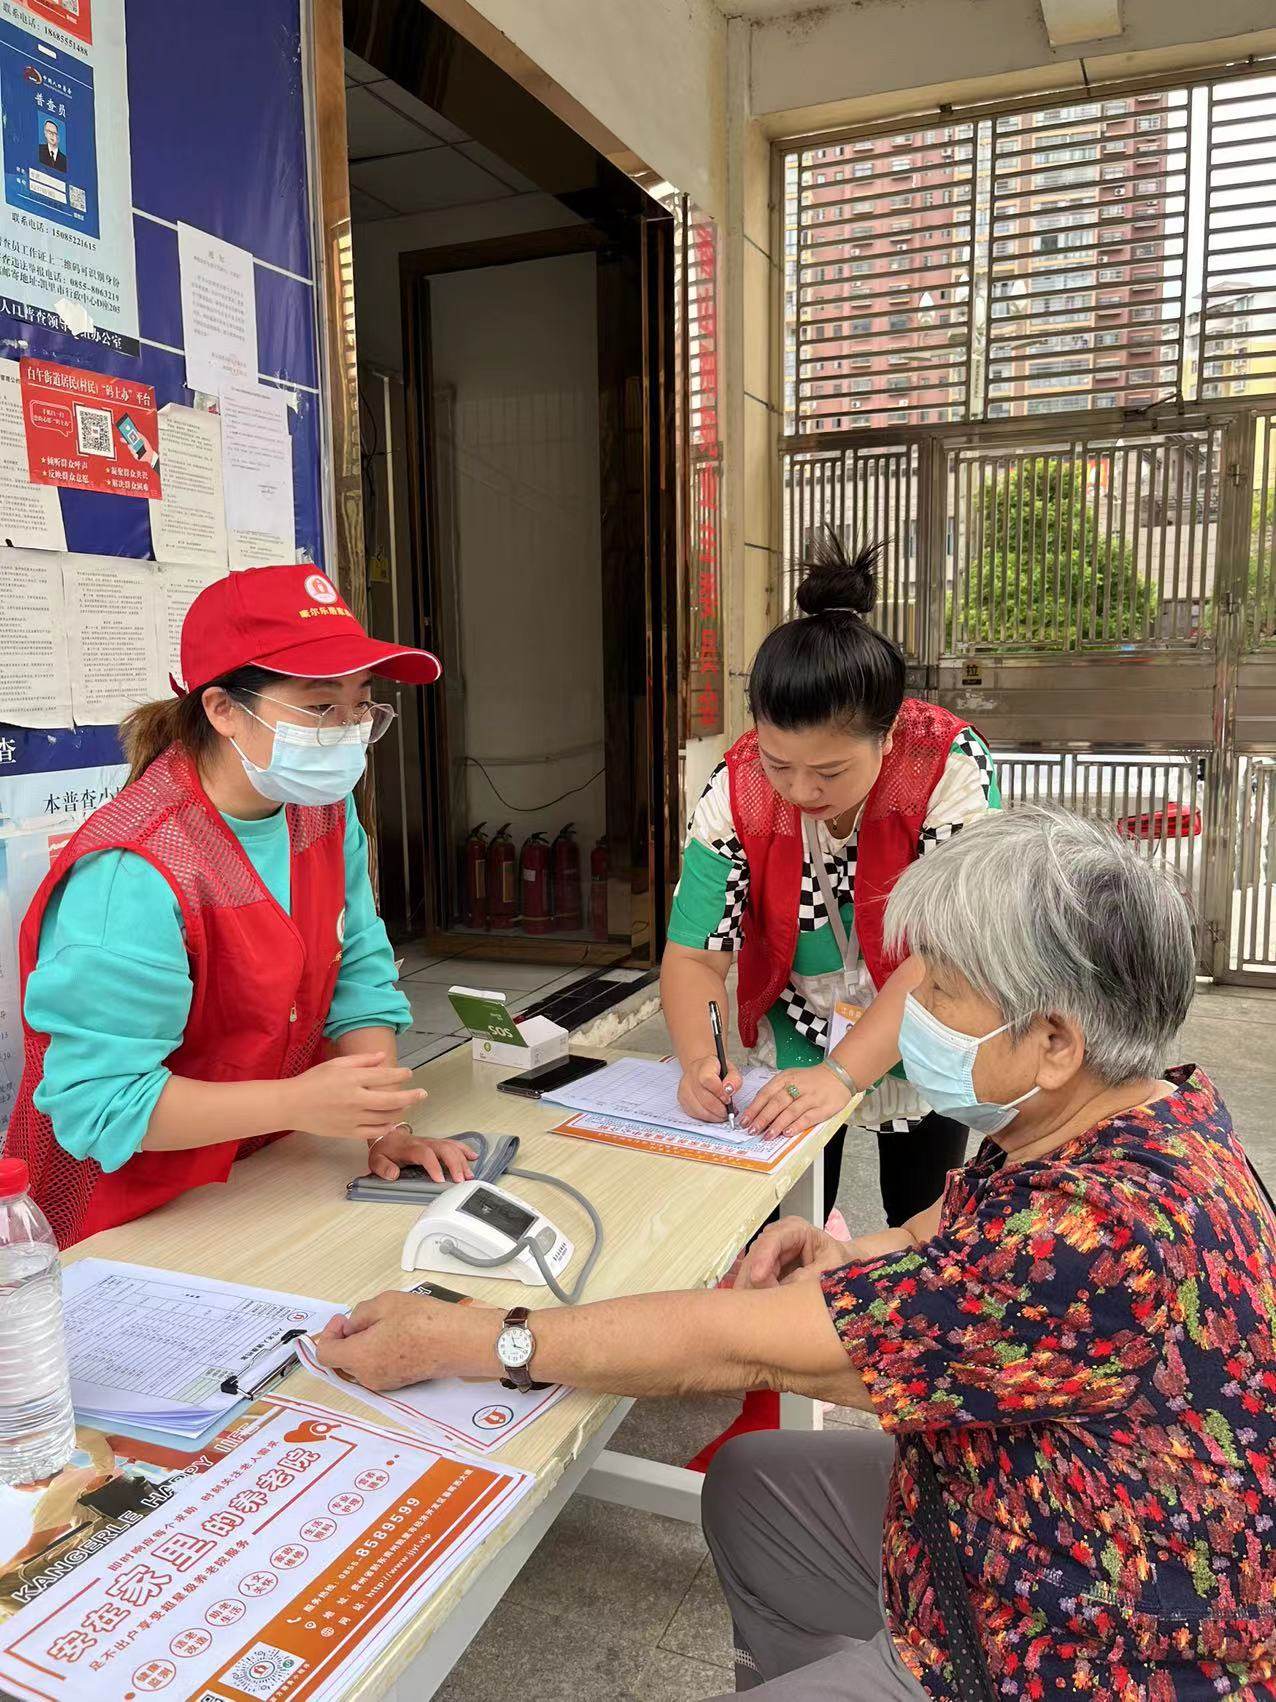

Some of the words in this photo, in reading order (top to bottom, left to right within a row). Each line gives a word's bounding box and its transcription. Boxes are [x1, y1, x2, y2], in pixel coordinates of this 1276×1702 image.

[34, 92, 67, 118] 普查员
[0, 236, 120, 288] 查员工作证上二维码可识别身份
[0, 299, 122, 350] 人口普查领导组办公室
[0, 737, 16, 764] 查
[43, 786, 122, 815] 本普查小
[488, 1025, 513, 1039] SOS
[331, 1495, 350, 1508] 专业
[304, 1520, 323, 1535] 生活
[107, 1505, 198, 1573] 即时响应每个求助
[11, 1510, 144, 1604] KANGERLE
[47, 1447, 321, 1663] 安在家里的养老院
[274, 1546, 295, 1563] 家政
[244, 1574, 264, 1590] 人文
[253, 1578, 274, 1594] 关怀
[89, 1539, 250, 1672] 足不出户享受超星级养老院服务
[209, 1602, 231, 1619] 助老
[220, 1606, 242, 1624] 生活
[184, 1636, 209, 1654] 改造
[147, 1667, 173, 1688] 监测
